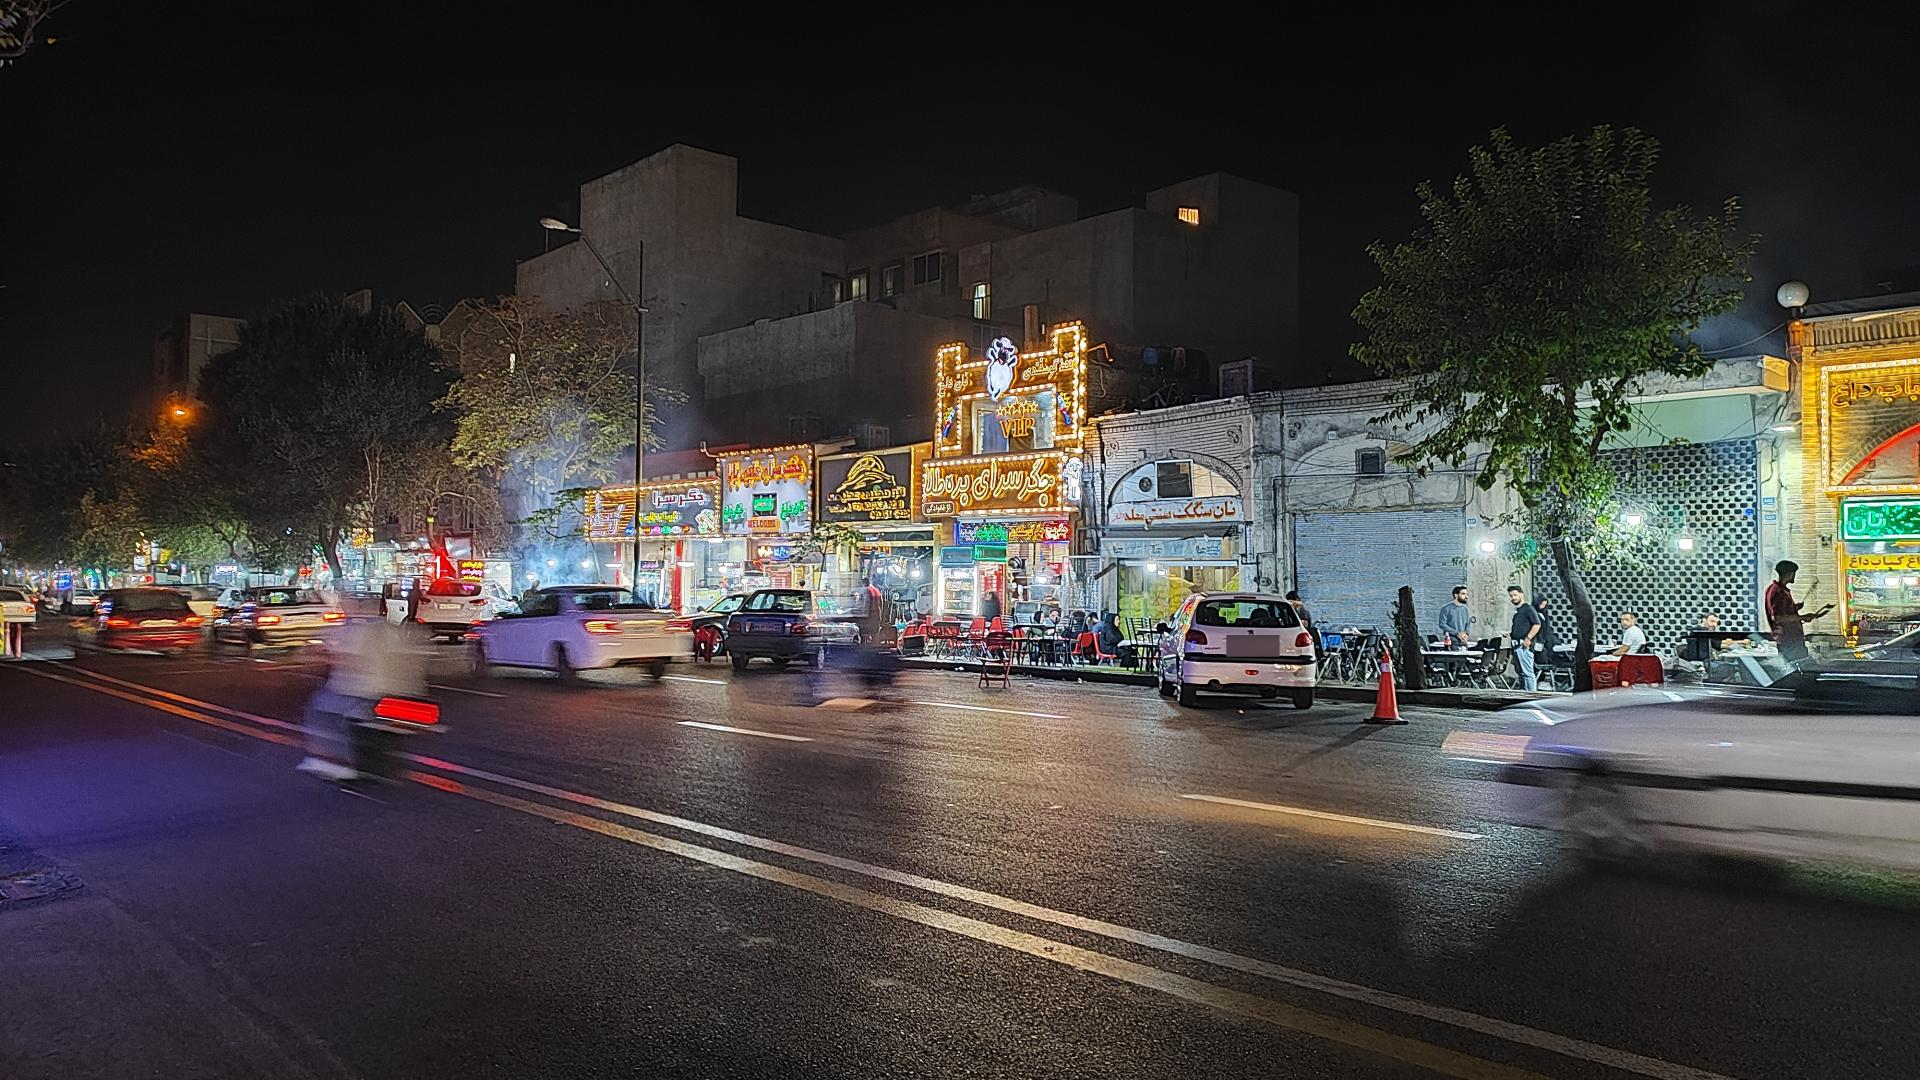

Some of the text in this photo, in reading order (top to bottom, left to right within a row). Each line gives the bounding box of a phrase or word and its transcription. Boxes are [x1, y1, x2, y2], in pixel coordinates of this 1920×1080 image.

[1023, 357, 1059, 380] گوسفندی
[1831, 376, 1920, 408] باب داغ
[1001, 418, 1035, 438] VIP
[924, 467, 944, 496] طلا
[944, 474, 970, 506] بره
[652, 487, 706, 508] جگر سرا
[1124, 508, 1144, 521] محله
[1173, 500, 1212, 519] سنگک
[1213, 500, 1236, 519] نان
[747, 519, 776, 529] WELCOME
[1849, 556, 1920, 568] اغ کباب داغ
